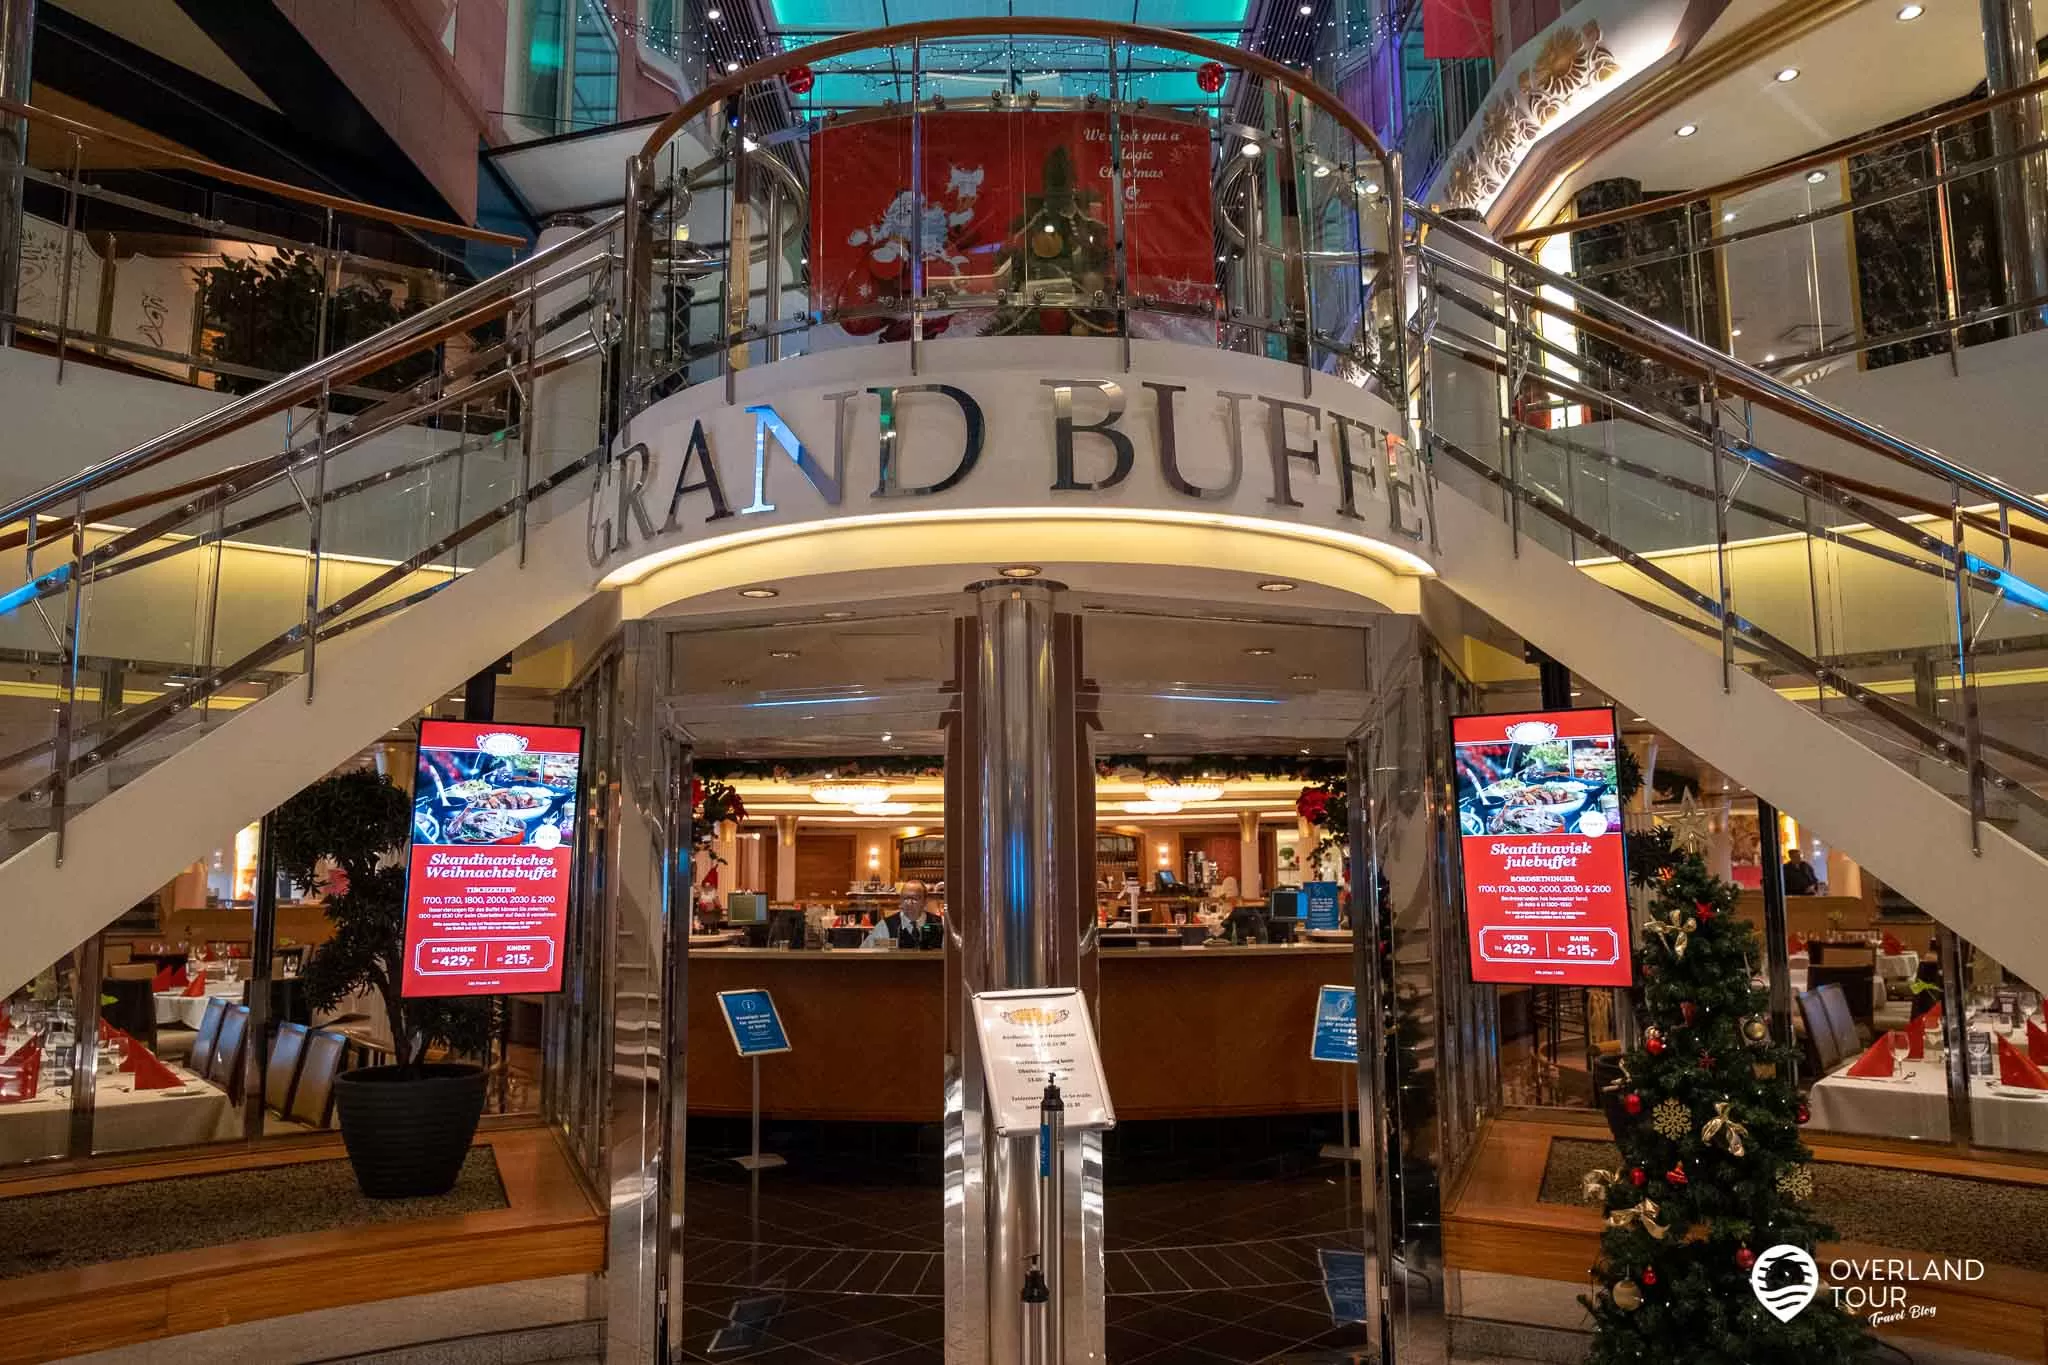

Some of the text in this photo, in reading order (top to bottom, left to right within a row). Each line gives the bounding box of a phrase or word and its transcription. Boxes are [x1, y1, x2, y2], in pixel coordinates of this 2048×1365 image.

[1083, 127, 1181, 145] We ish you a
[1099, 166, 1163, 179] Chistmas
[587, 377, 1442, 568] GRAND BUFFET
[1490, 841, 1592, 856] Skandinavisk
[429, 852, 555, 867] Skandinavisches
[1504, 855, 1577, 870] julebuffet
[426, 865, 558, 881] Weihnachtsbuffet
[1478, 886, 1496, 894] 1700,
[1498, 886, 1516, 894] 1730,
[1517, 886, 1538, 894] 1800,
[1539, 886, 1562, 894] 2000,
[423, 896, 442, 904] 1700,
[444, 896, 463, 904] 1730,
[465, 896, 485, 904] 1800,
[486, 896, 508, 904] 2000,
[509, 896, 529, 904] 2030
[1503, 943, 1536, 956] 429,-
[1567, 944, 1599, 957] 215,-
[440, 955, 475, 967] 429,-
[504, 954, 535, 965] 215,-
